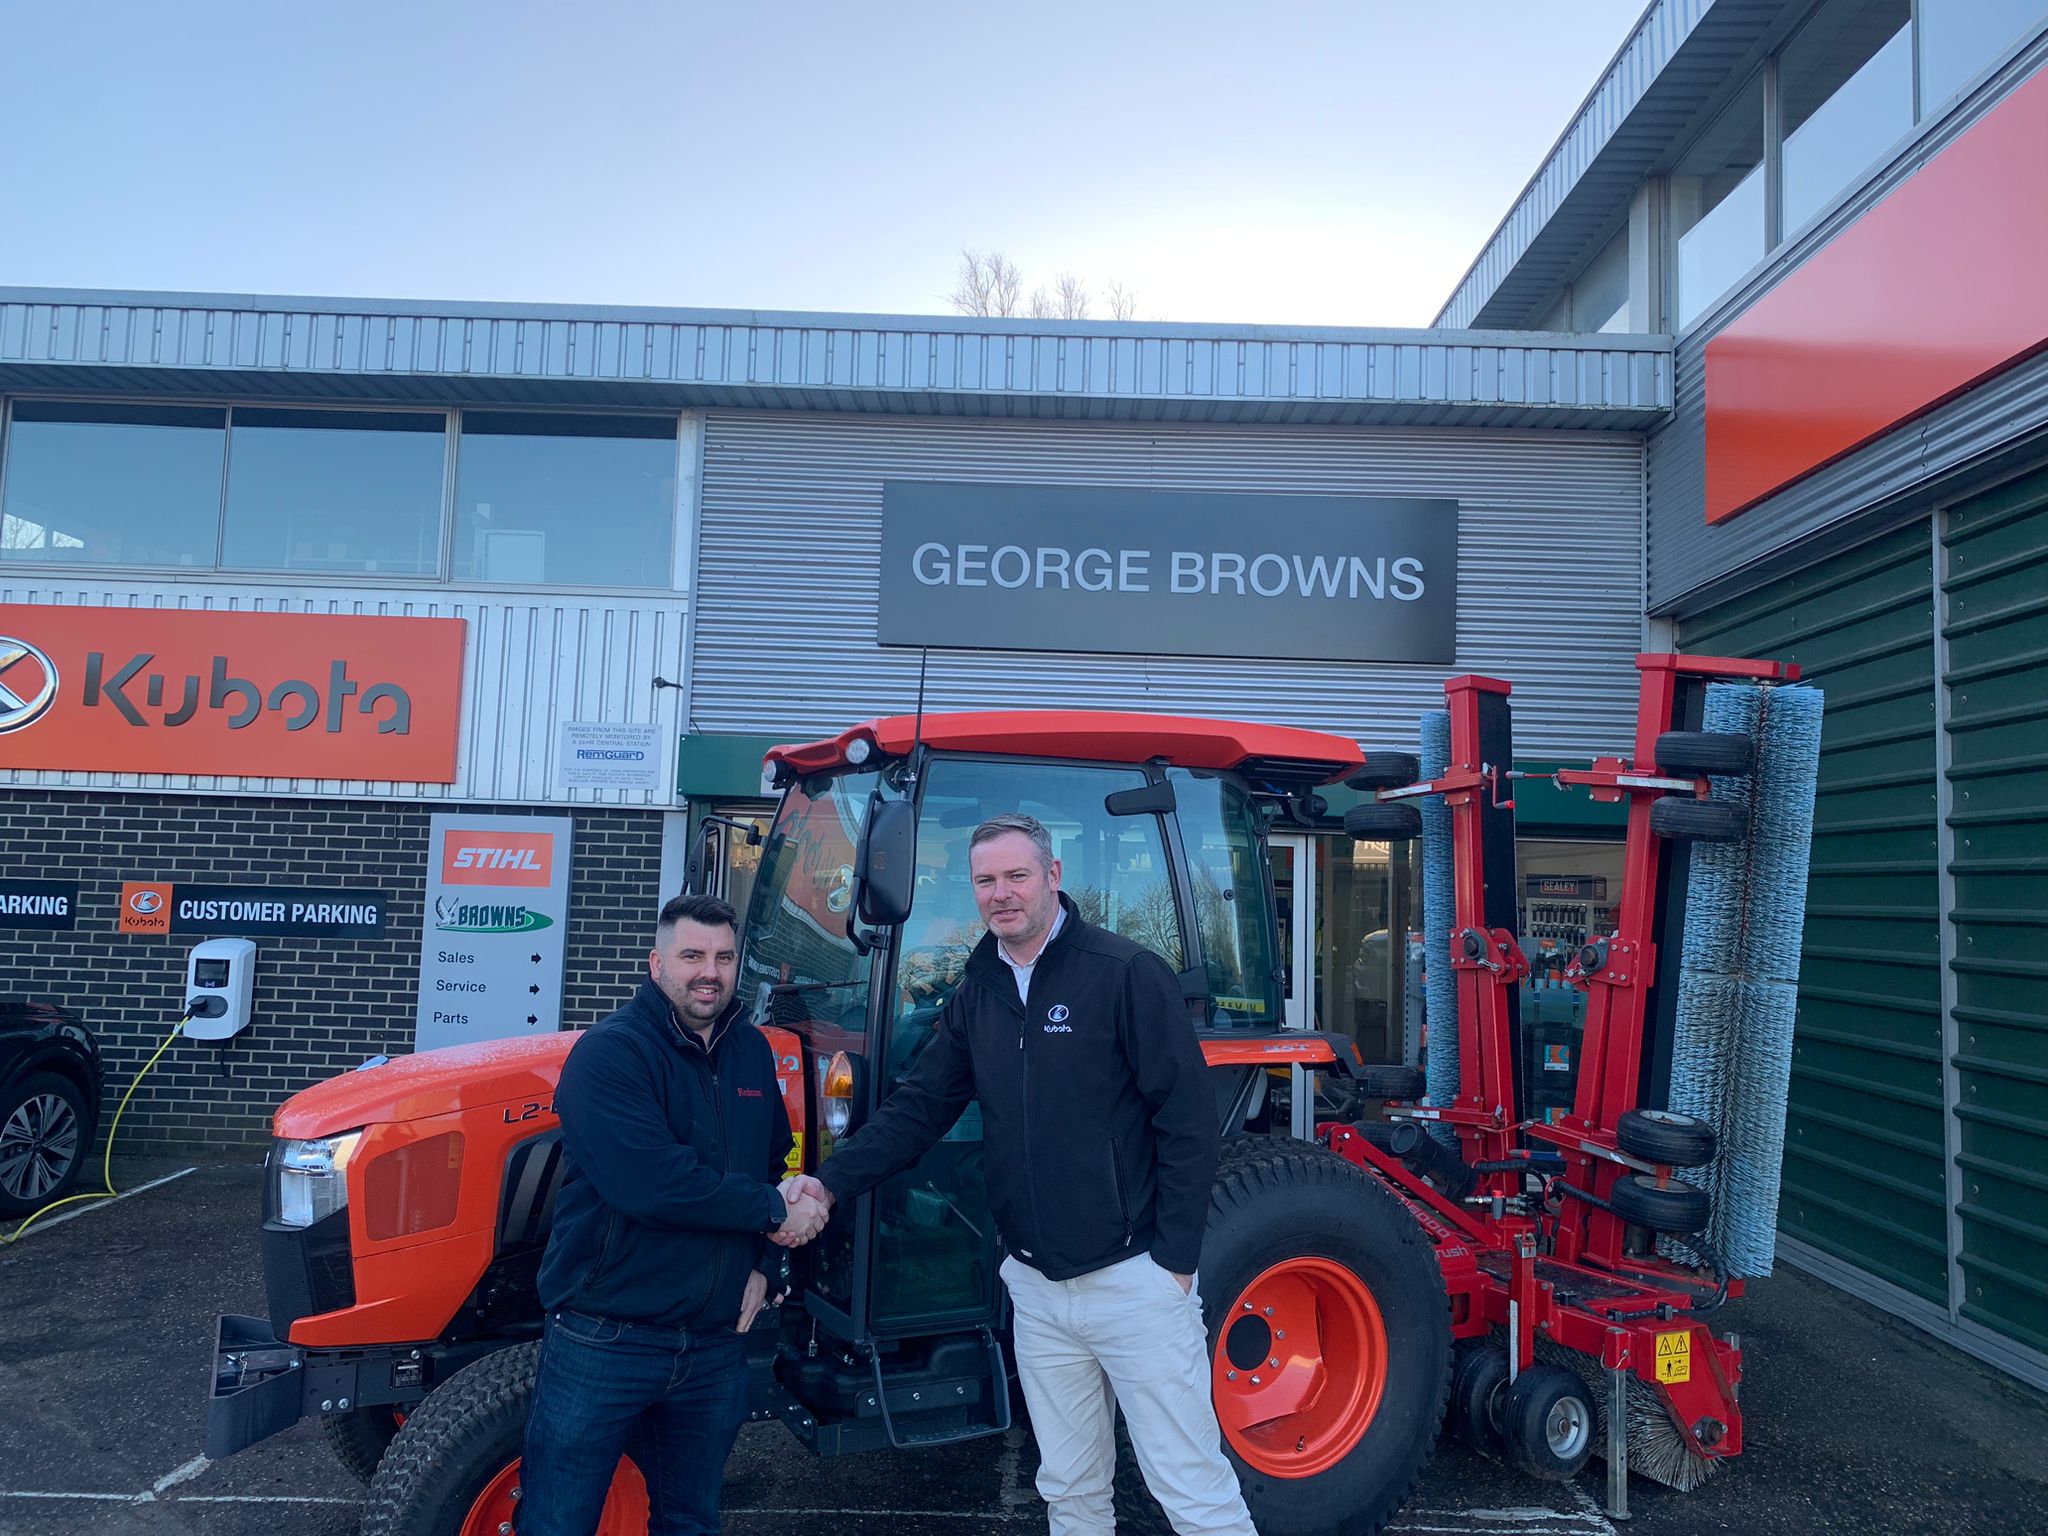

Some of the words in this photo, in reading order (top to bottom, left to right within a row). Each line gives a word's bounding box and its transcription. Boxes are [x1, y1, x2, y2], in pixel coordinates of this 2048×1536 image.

[912, 542, 1151, 592] GEORGE
[1170, 551, 1425, 601] BROWNS
[83, 651, 411, 734] Kubota
[453, 848, 541, 870] STIHL
[1543, 881, 1575, 893] SEALEY
[125, 916, 165, 928] Kubota
[179, 900, 285, 922] CUSTOMER
[291, 904, 377, 925] PARKING
[458, 905, 526, 927] BROWNS
[438, 951, 475, 964] Sales
[436, 979, 487, 993] Service
[433, 1011, 469, 1025] Parts
[1043, 1024, 1073, 1033] Kubota
